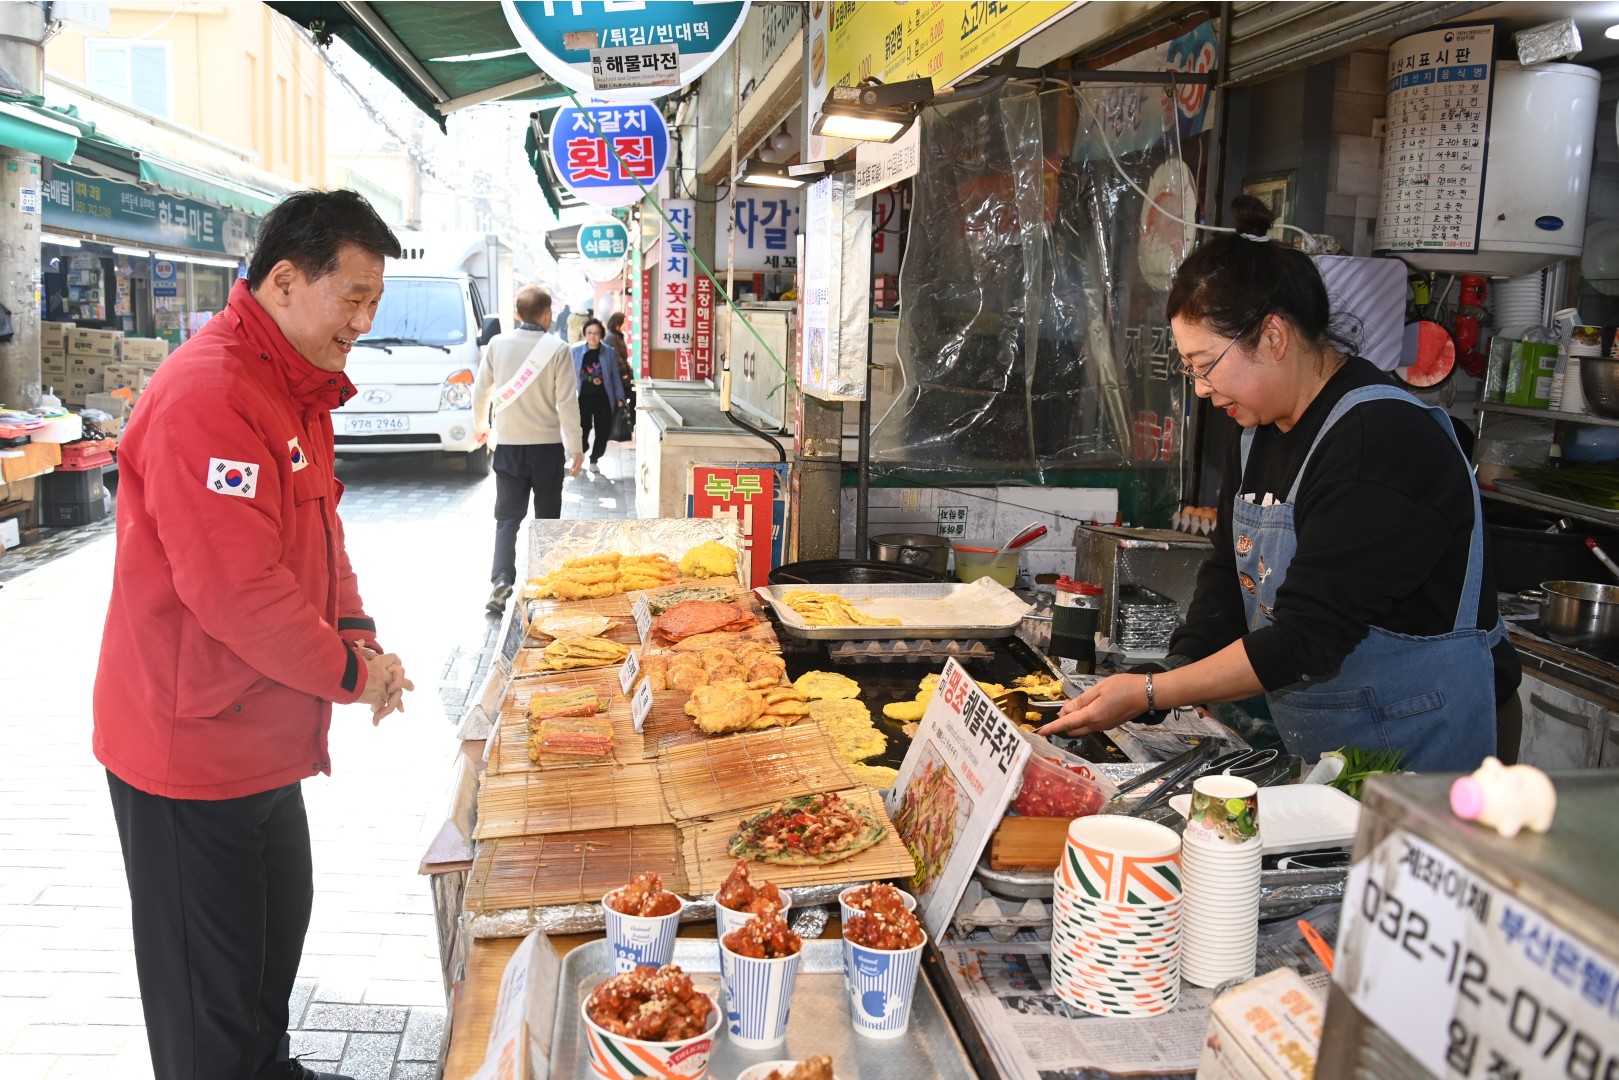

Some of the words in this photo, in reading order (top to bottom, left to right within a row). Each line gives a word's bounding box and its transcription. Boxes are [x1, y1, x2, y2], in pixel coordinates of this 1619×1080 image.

[885, 21, 903, 61] 닭강정
[606, 52, 678, 74] 해물파전
[1441, 67, 1483, 80] 음식명
[572, 109, 647, 134] 자갈치
[567, 136, 655, 182] 횟집
[159, 200, 215, 243] 한국마트
[735, 199, 800, 250] 자갈
[585, 239, 625, 255] 식육점
[666, 208, 691, 279] 자갈치
[665, 282, 689, 329] 횟집
[663, 332, 691, 344] 자연산
[696, 279, 711, 376] 포장해드립니다
[376, 418, 403, 429] 2946
[704, 473, 762, 502] 녹두
